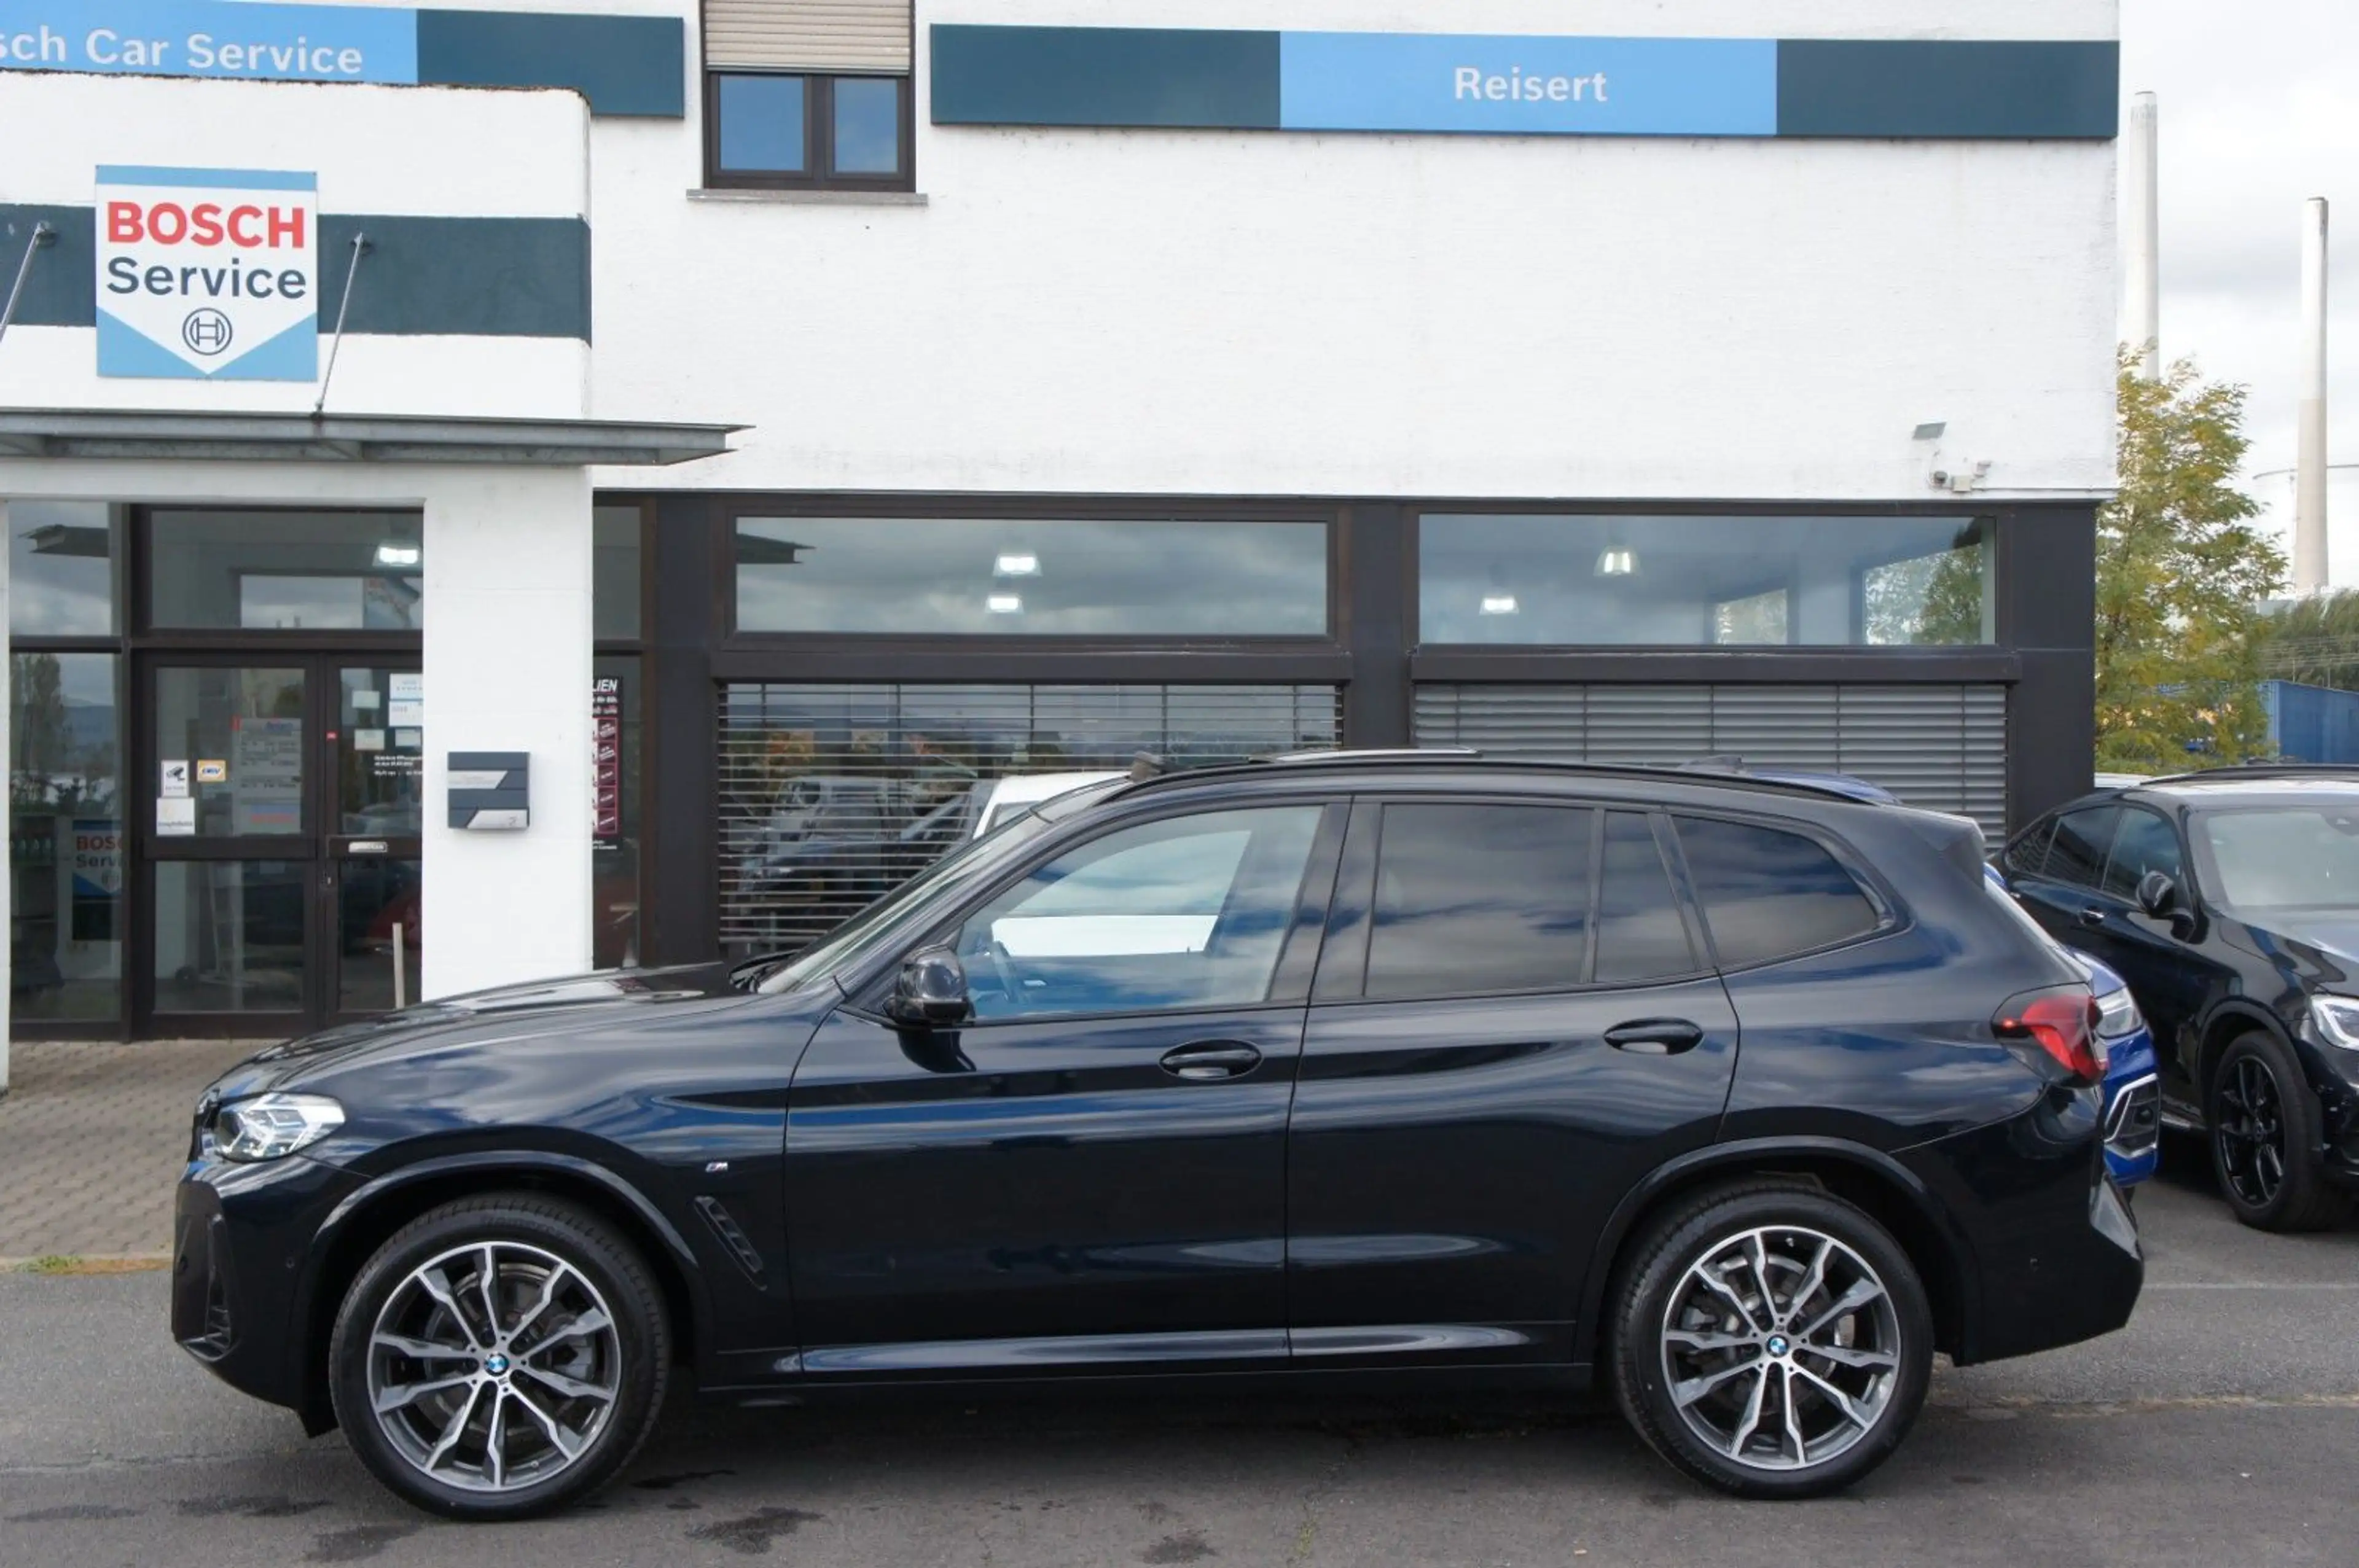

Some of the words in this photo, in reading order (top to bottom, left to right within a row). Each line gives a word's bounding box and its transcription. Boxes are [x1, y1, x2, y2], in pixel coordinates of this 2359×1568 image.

[86, 29, 168, 66] Car
[187, 34, 362, 73] Service
[1455, 66, 1608, 102] Reisert
[107, 201, 305, 249] BOSCH
[107, 257, 307, 299] Service
